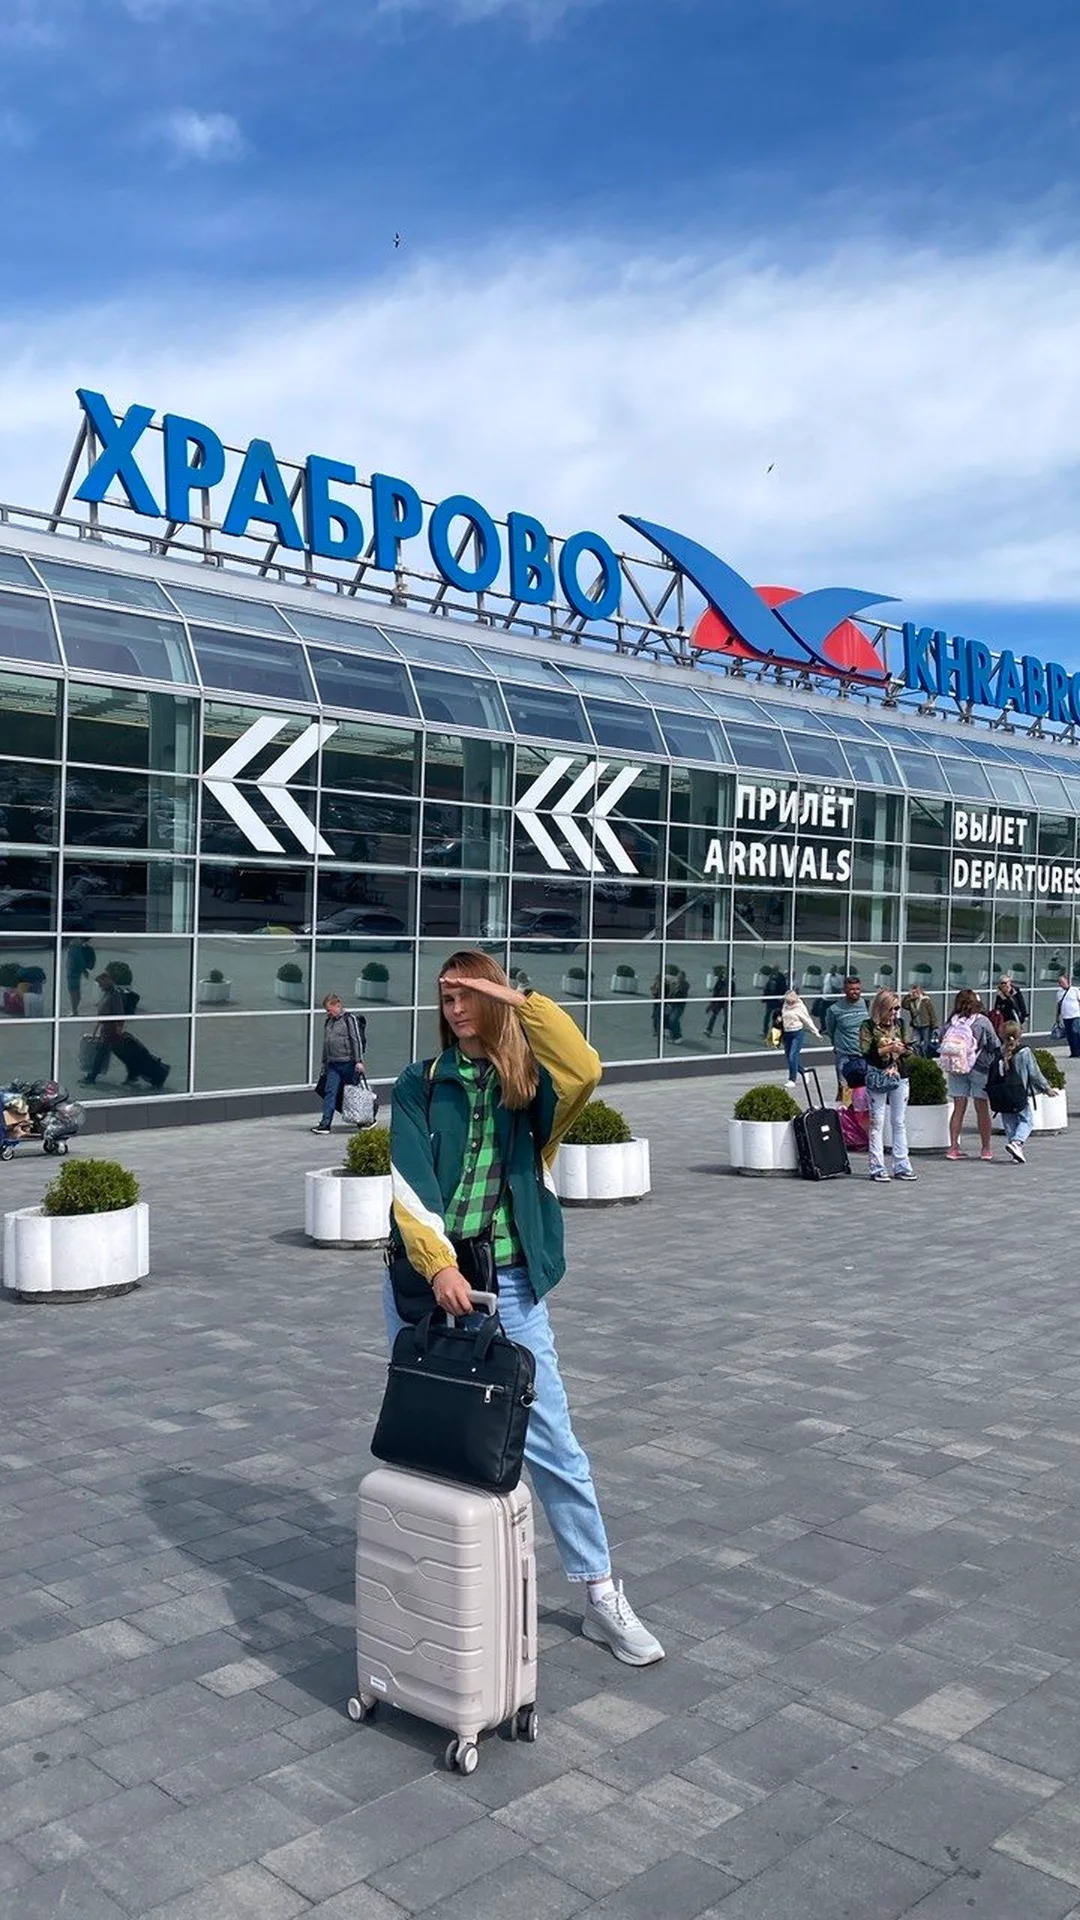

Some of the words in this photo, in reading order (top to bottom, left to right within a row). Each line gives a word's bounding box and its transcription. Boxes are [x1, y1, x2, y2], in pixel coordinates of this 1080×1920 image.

[74, 388, 622, 621] ХРАБРОВО
[736, 785, 855, 829] ПРИЛЁТ
[954, 810, 1028, 846] ВЫЛЕТ
[703, 838, 851, 882] ARRIVALS
